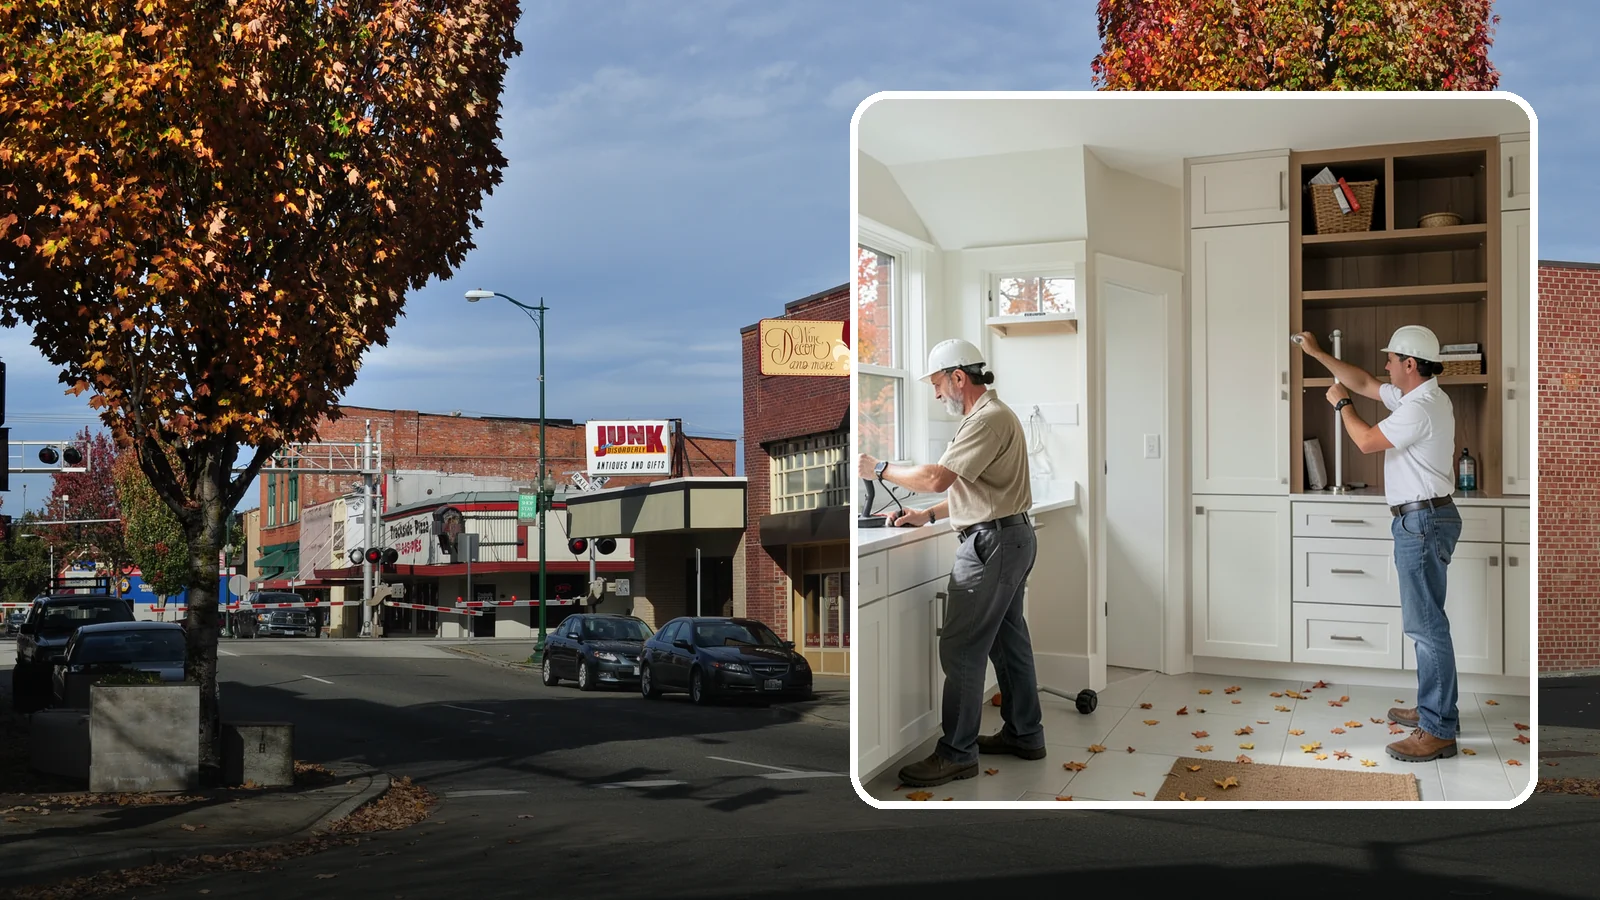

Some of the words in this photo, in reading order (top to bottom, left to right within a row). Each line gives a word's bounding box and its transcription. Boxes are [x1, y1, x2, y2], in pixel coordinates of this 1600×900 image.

[595, 425, 666, 457] JUNK
[607, 446, 646, 454] DISORDERLY
[597, 461, 628, 470] ANTIQUES
[631, 461, 644, 470] AND
[647, 460, 665, 469] GIFTS
[390, 520, 412, 540] Trackside
[414, 519, 429, 534] Pizza
